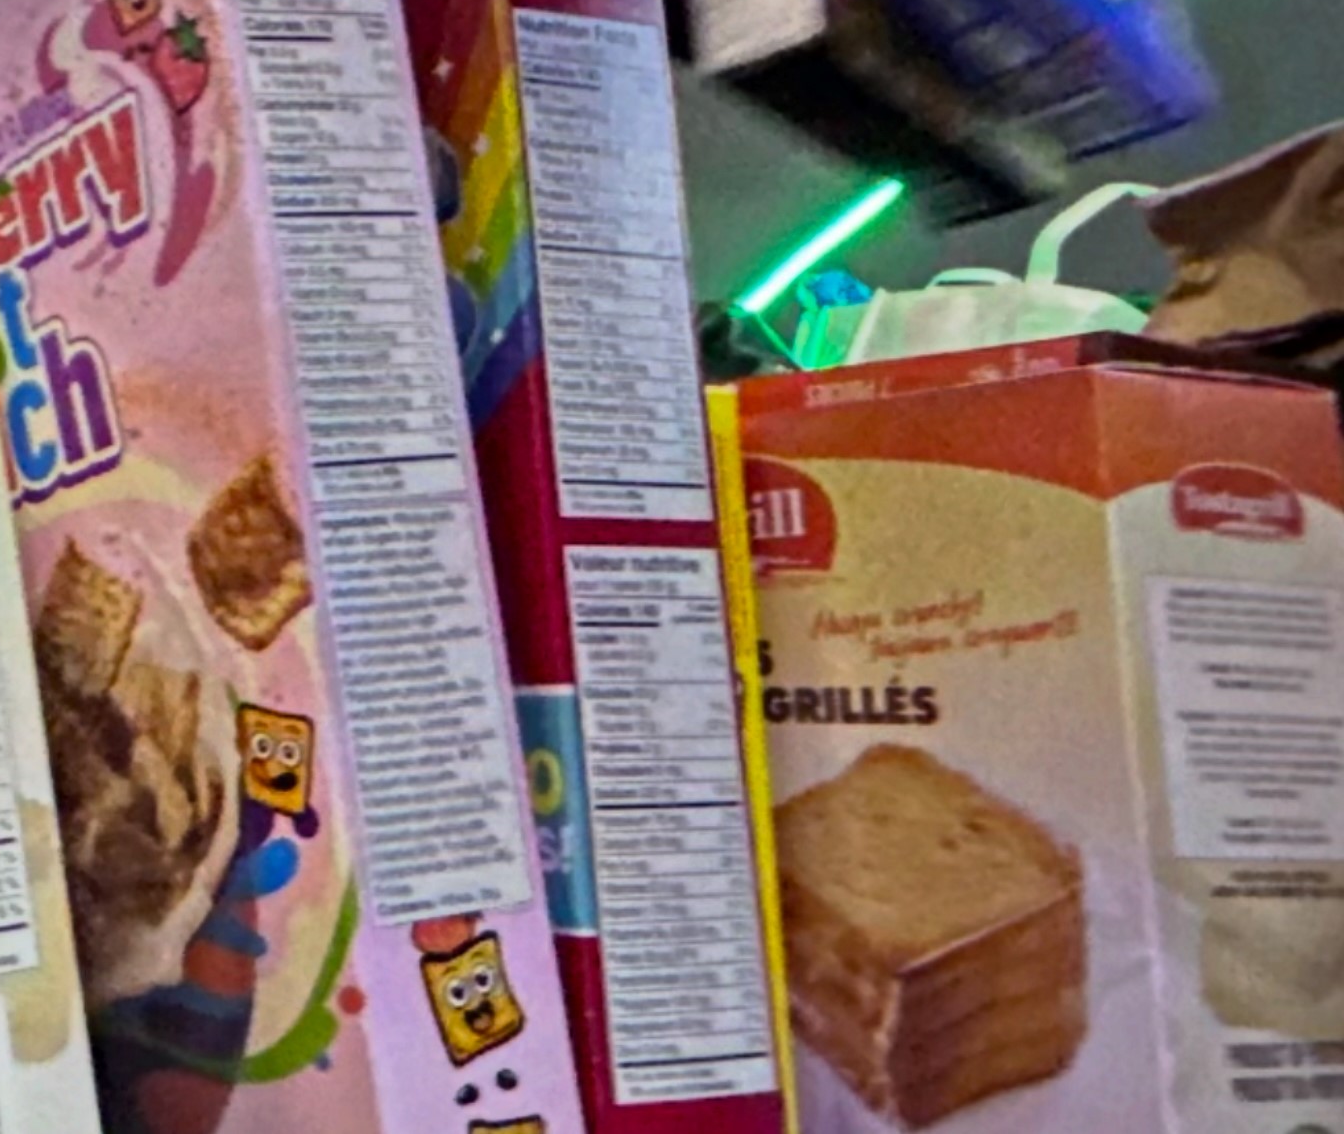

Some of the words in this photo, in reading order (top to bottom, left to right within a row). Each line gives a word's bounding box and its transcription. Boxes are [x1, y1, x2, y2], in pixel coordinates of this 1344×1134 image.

[8, 332, 115, 482] ch
[746, 487, 807, 541] ill
[762, 674, 940, 725] GRILLÉS
